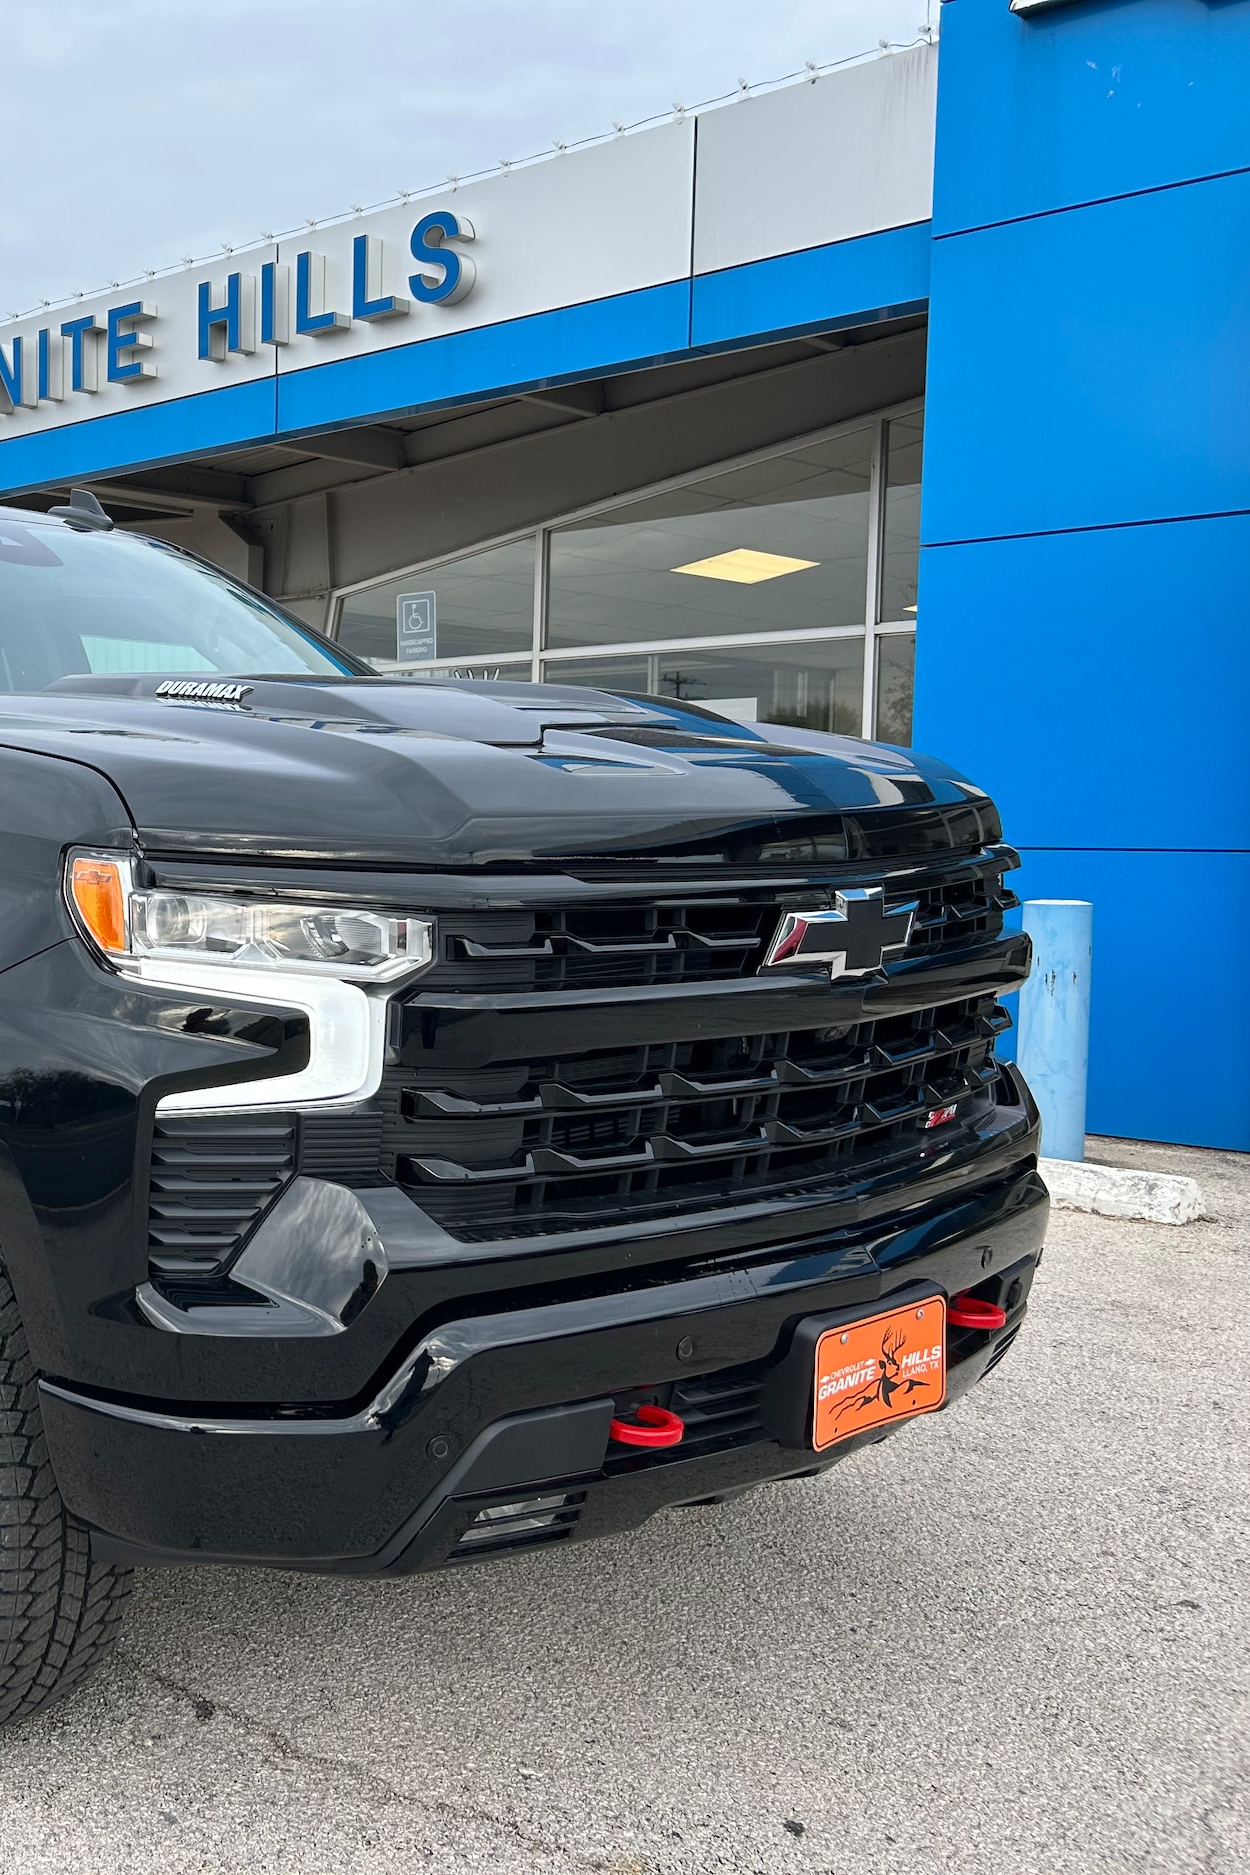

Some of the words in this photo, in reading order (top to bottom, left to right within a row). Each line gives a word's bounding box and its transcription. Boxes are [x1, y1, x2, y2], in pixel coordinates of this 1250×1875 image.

[197, 211, 475, 362] HILLS
[400, 637, 434, 646] HANDICAPPED
[405, 646, 428, 654] PARKING
[155, 680, 254, 701] DURAMAX
[925, 1103, 958, 1128] Z71
[901, 1345, 942, 1369] HILLS
[830, 1361, 865, 1380] CHEVROLET
[902, 1364, 928, 1378] LLANO,
[929, 1360, 939, 1369] TX
[818, 1366, 877, 1400] GRANITE
